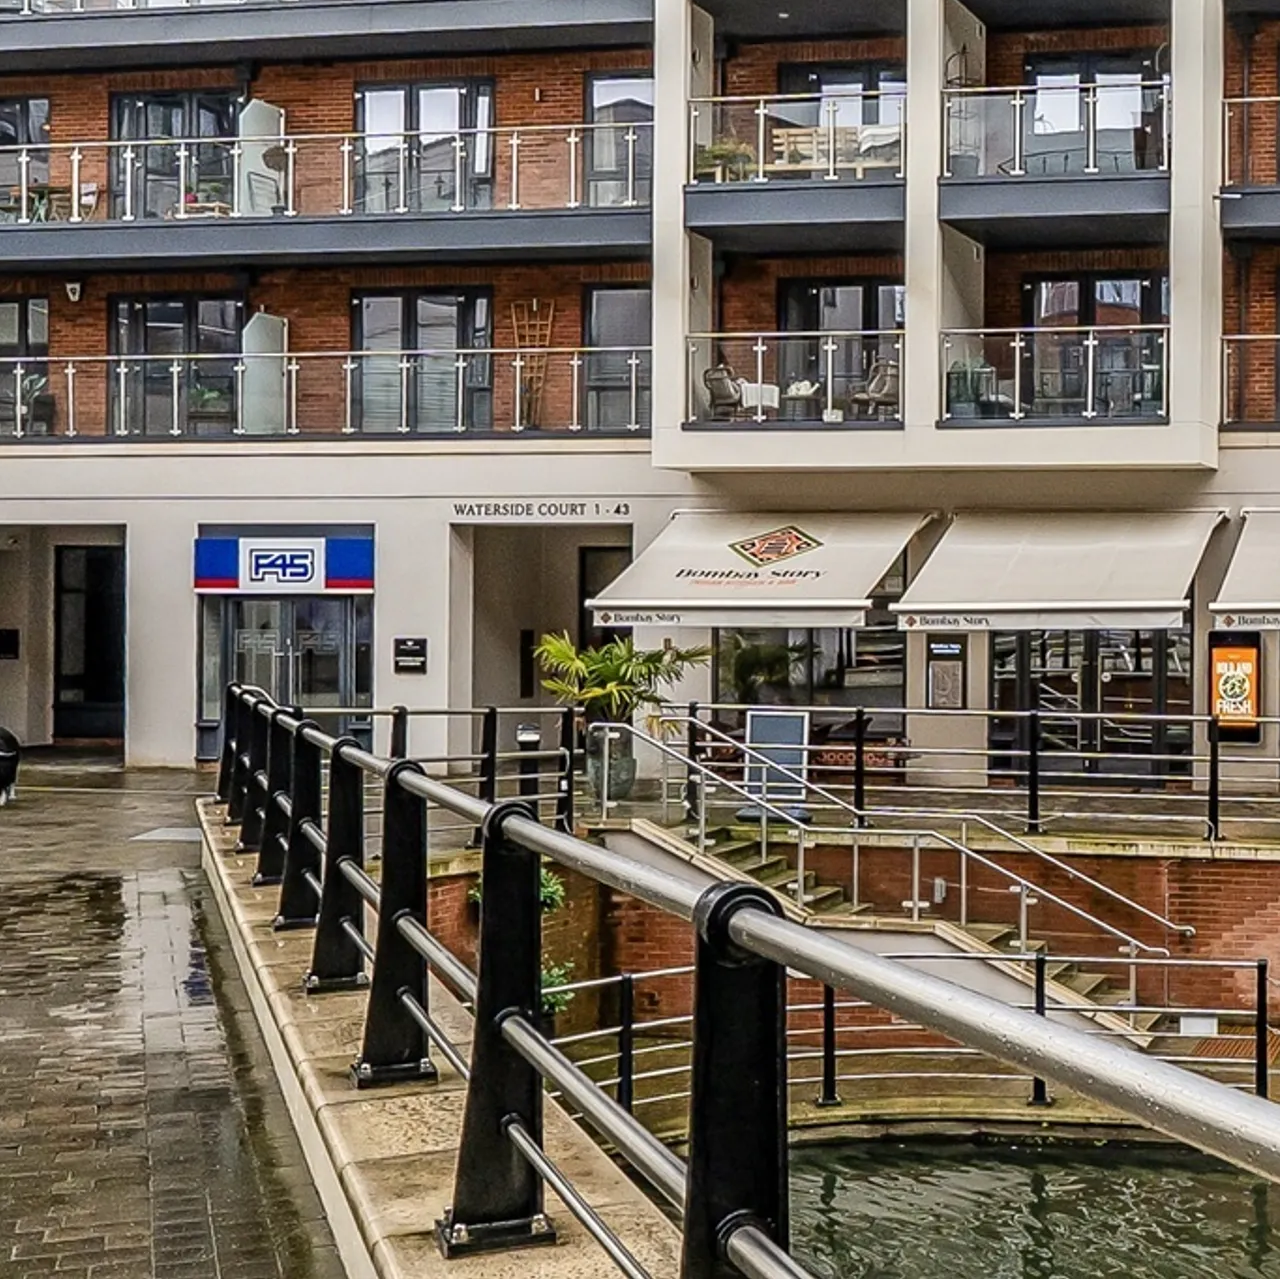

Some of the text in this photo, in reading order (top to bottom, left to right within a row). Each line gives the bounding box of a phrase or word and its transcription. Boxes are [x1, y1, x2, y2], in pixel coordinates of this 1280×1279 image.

[453, 503, 534, 516] WATERSIDE
[537, 503, 587, 516] COURT
[613, 503, 630, 516] 43
[252, 552, 312, 580] F45
[675, 568, 827, 581] Bombay Story
[920, 616, 961, 627] Bombay
[1238, 616, 1280, 627] Bombay
[1216, 699, 1252, 716] FRESH
